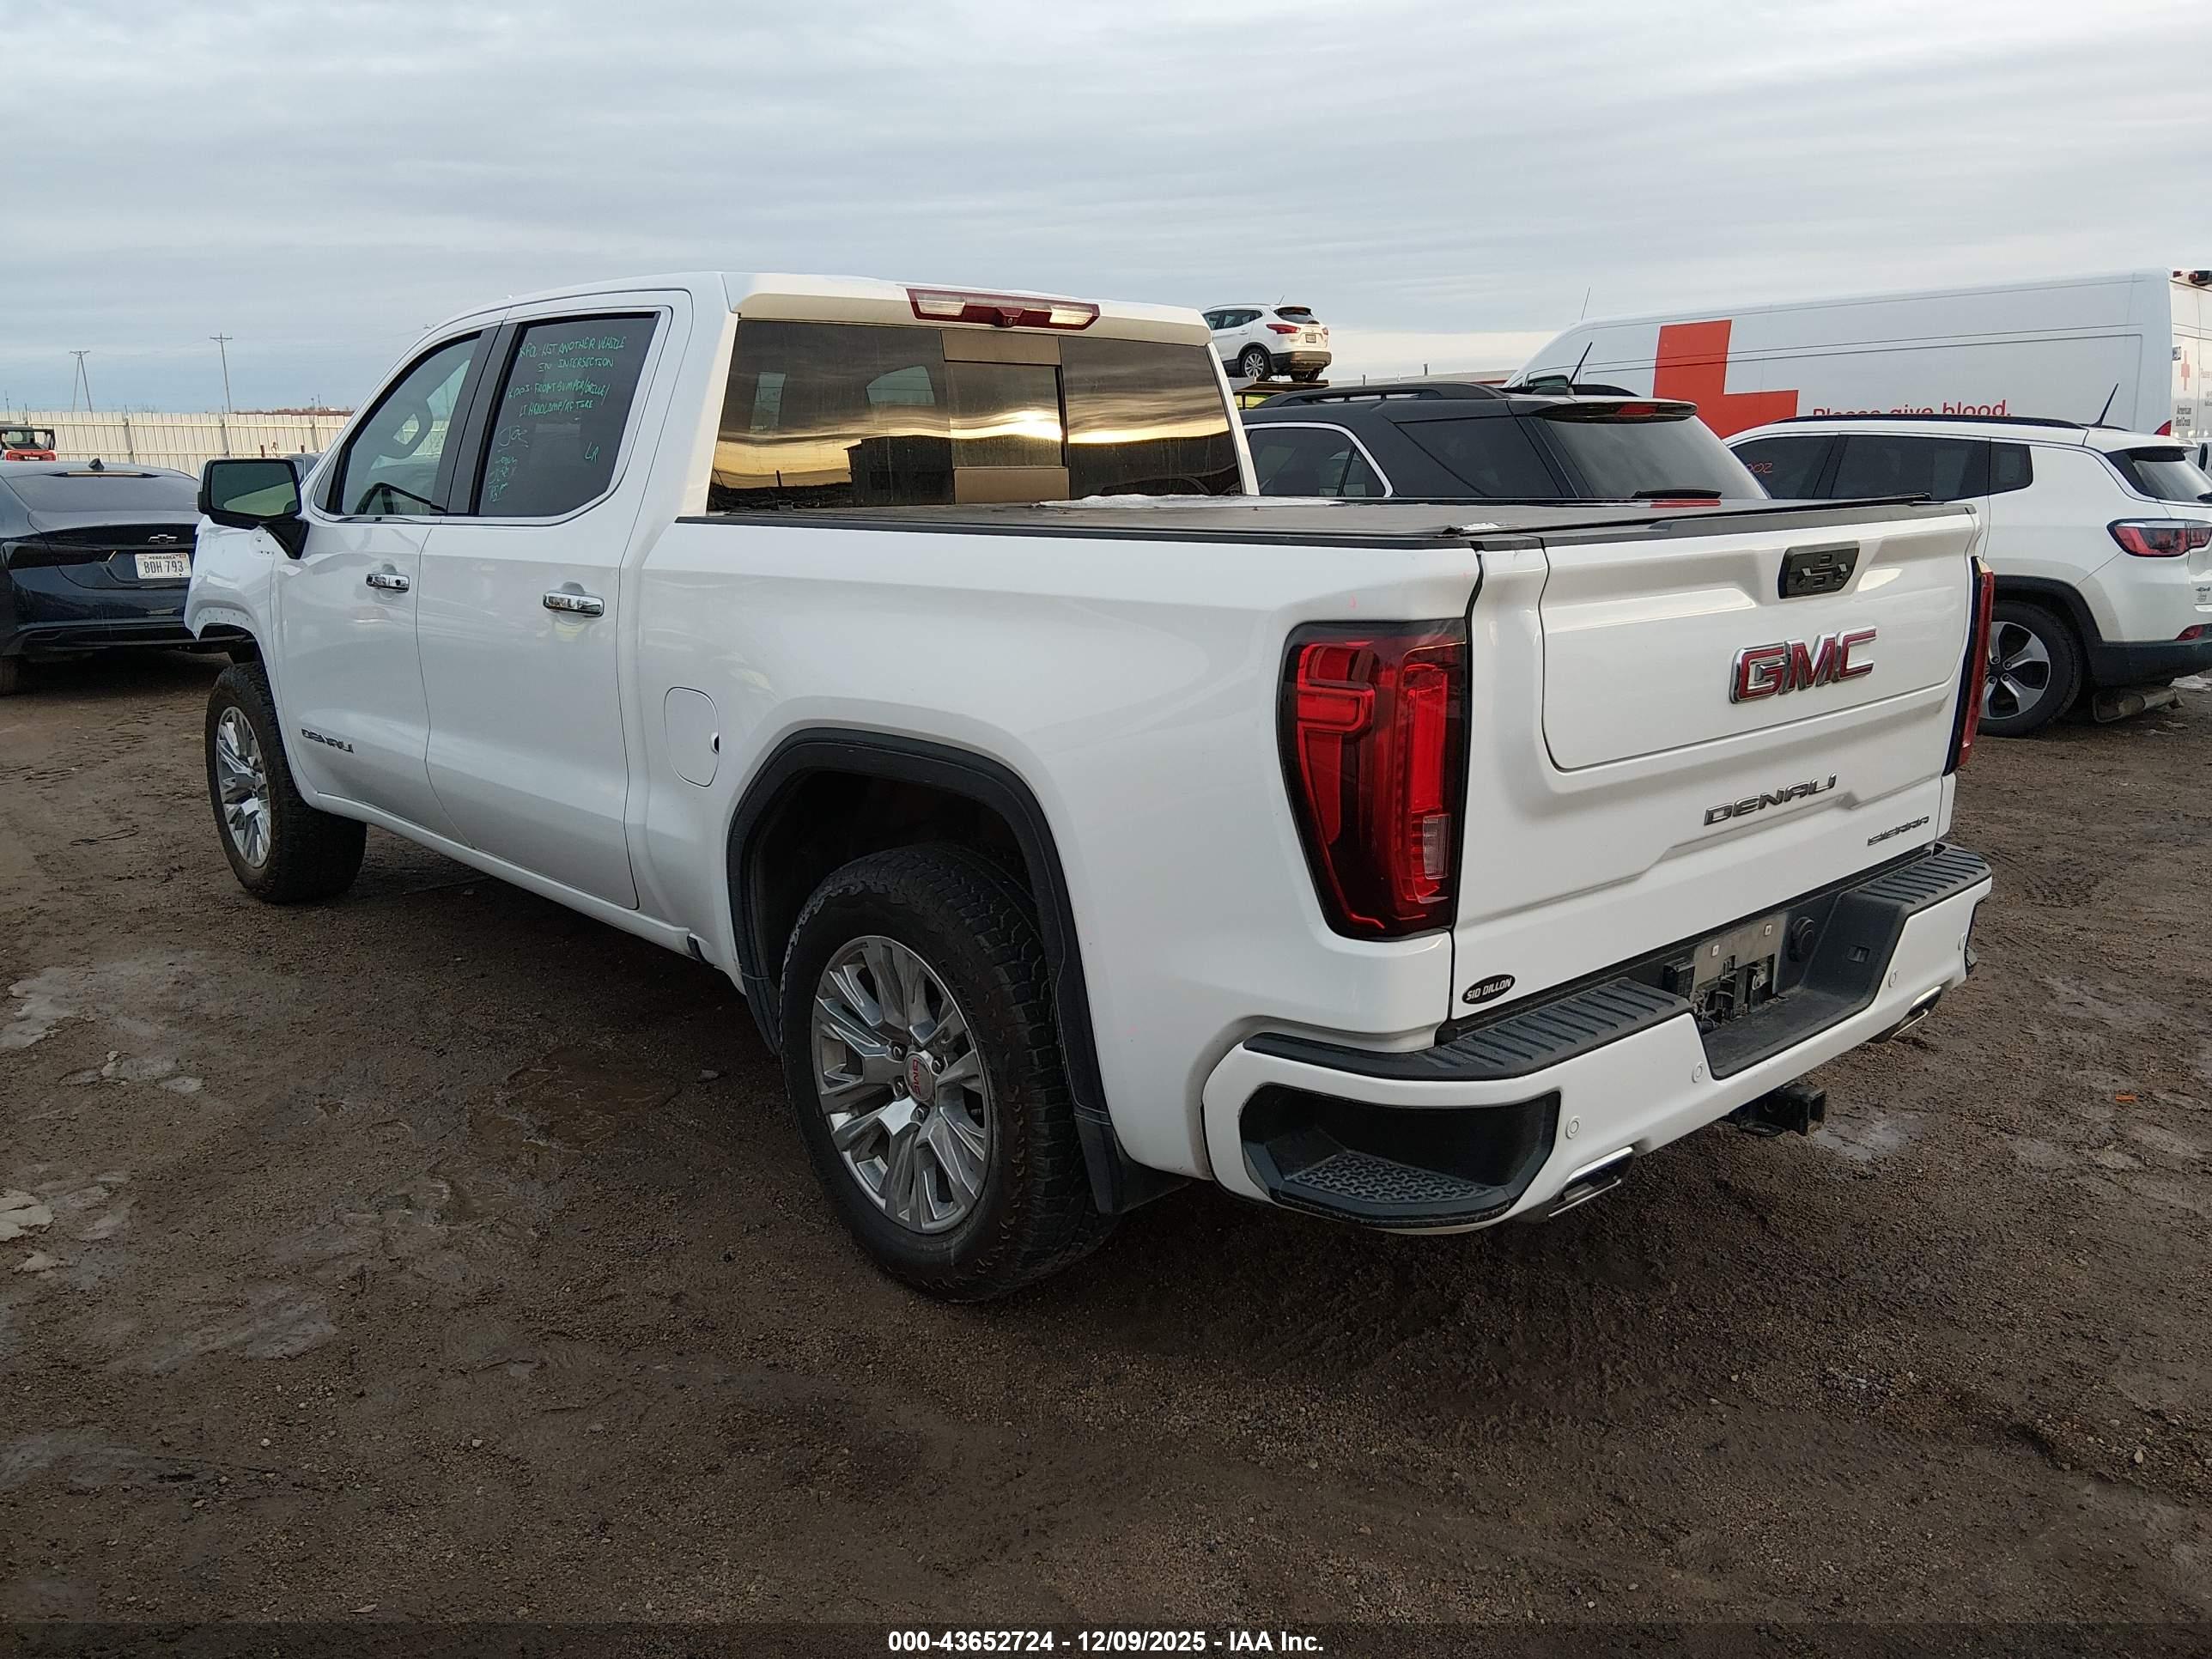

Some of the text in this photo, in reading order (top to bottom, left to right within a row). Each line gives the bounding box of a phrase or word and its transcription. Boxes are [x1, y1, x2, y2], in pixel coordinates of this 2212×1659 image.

[165, 560, 184, 573] 793
[1729, 625, 1877, 704] GMC
[301, 727, 355, 753] DENALI
[1704, 773, 1838, 826] DENALI
[1867, 816, 1929, 847] SIERRA
[1466, 977, 1512, 1001] SID DILLON
[911, 1058, 921, 1097] GMC
